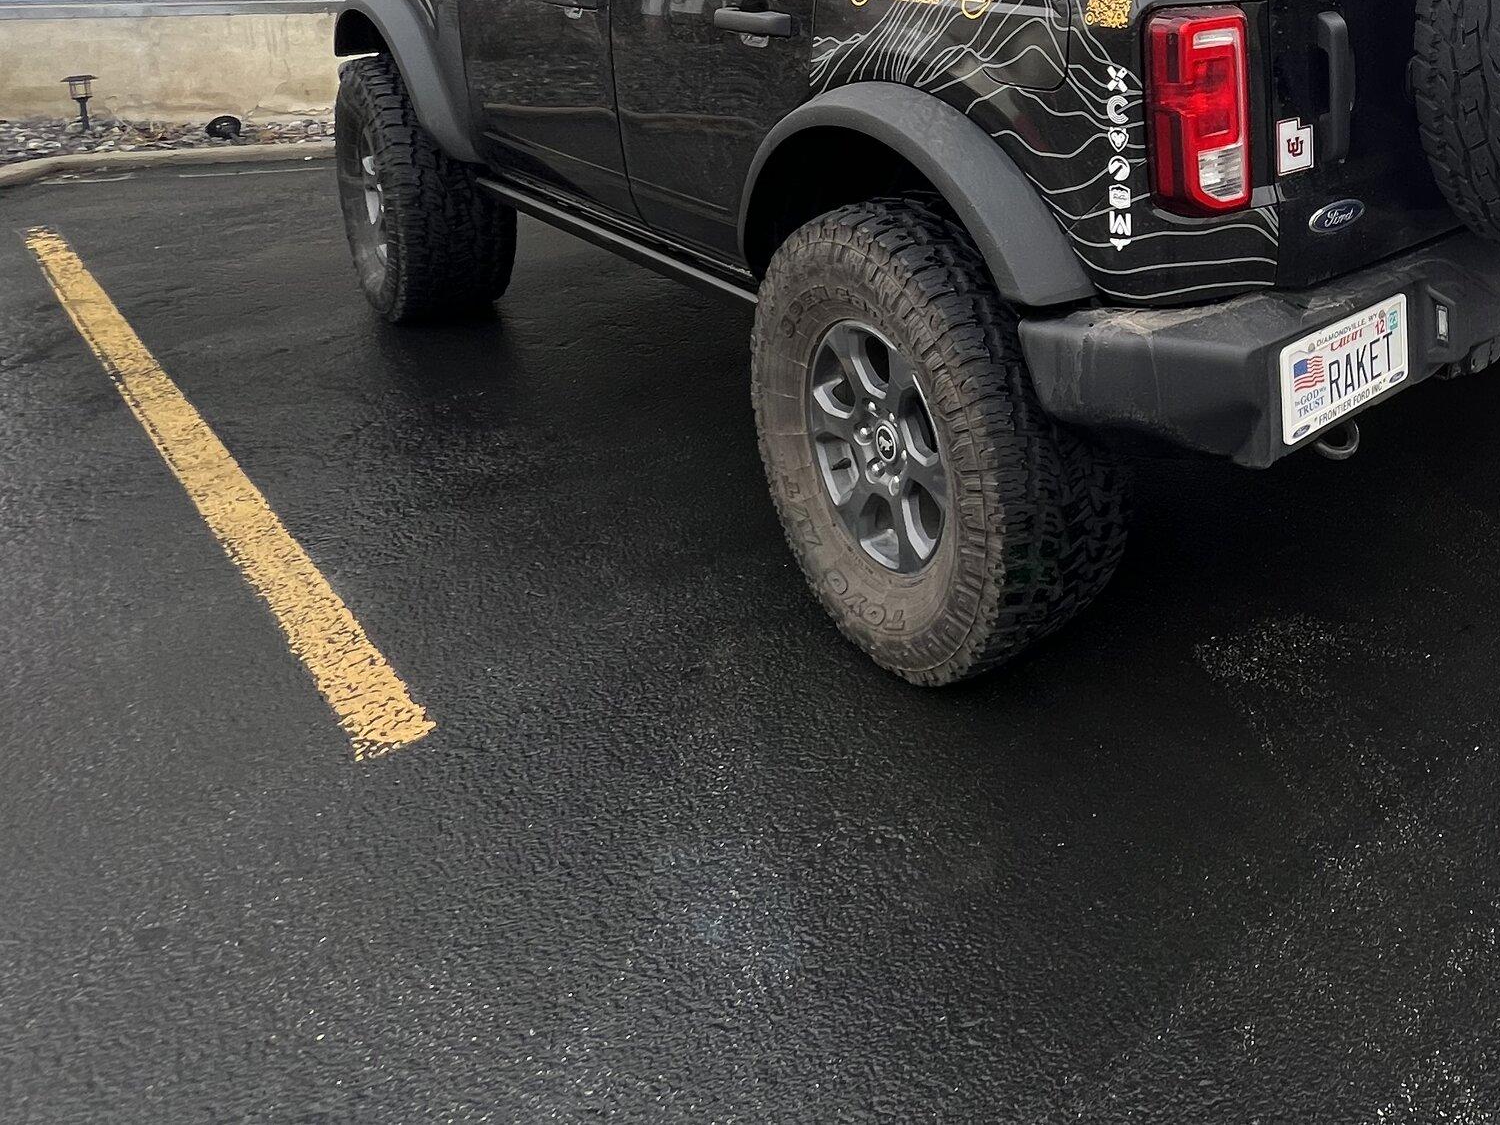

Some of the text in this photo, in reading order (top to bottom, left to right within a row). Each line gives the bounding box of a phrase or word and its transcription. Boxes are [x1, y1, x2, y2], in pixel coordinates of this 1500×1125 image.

[1375, 319, 1385, 336] 12
[1328, 331, 1393, 404] RAKET
[1297, 395, 1325, 417] TRUST
[1300, 388, 1319, 405] GOD
